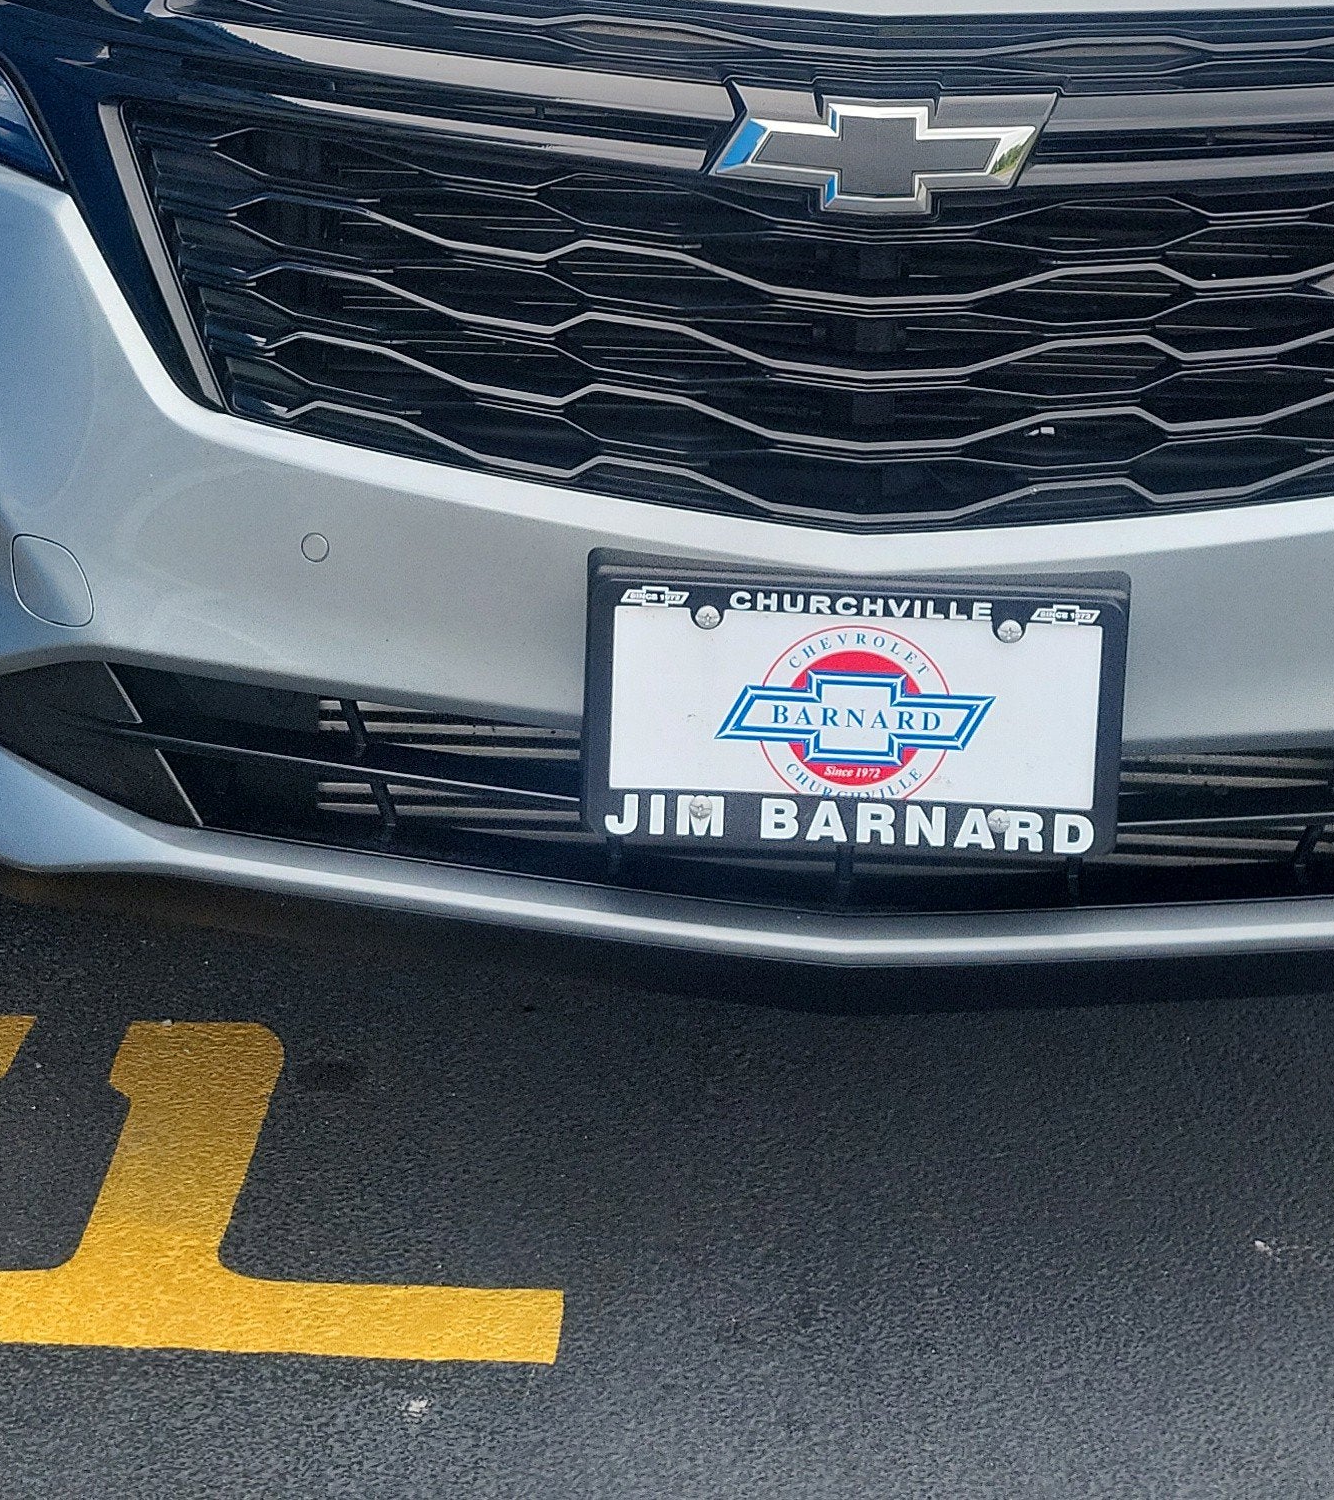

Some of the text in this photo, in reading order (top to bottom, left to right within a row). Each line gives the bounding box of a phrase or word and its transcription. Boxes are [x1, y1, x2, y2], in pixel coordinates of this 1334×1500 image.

[729, 590, 993, 621] CHURCHVILLE
[788, 632, 931, 675] CHEVROLET
[771, 704, 942, 731] BARNARD
[823, 765, 882, 779] Since 1972
[604, 793, 1095, 854] JIM BARNARD
